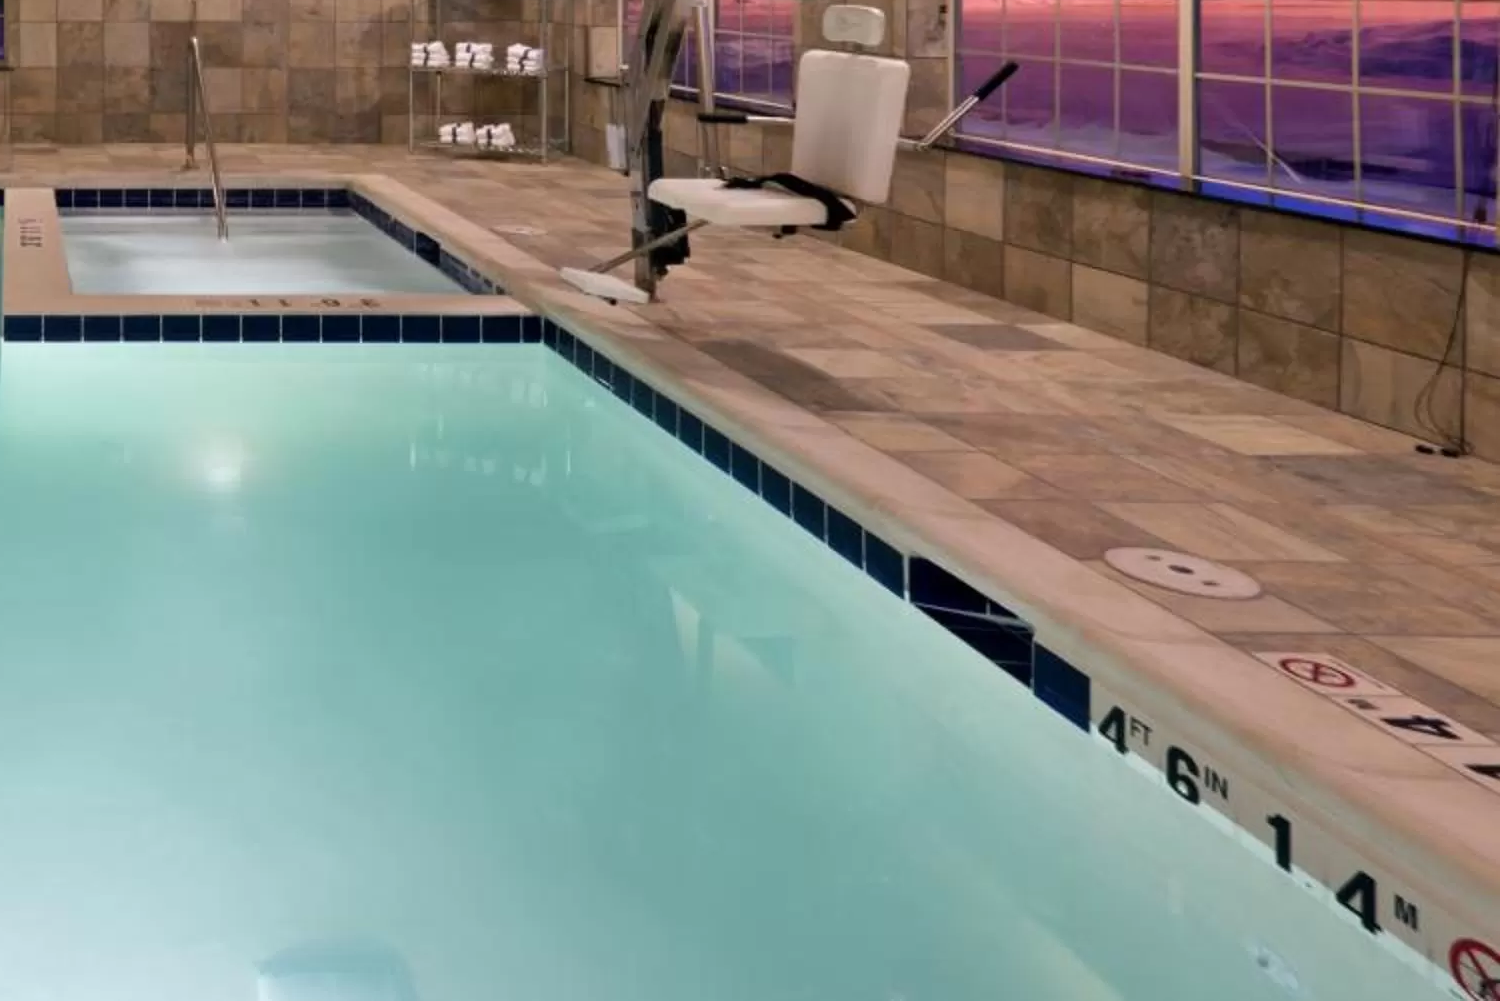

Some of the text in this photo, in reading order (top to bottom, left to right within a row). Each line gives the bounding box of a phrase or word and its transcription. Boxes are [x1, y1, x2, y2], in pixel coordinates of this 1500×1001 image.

[1098, 705, 1419, 935] 4 FT 6 IN 1 4 M
